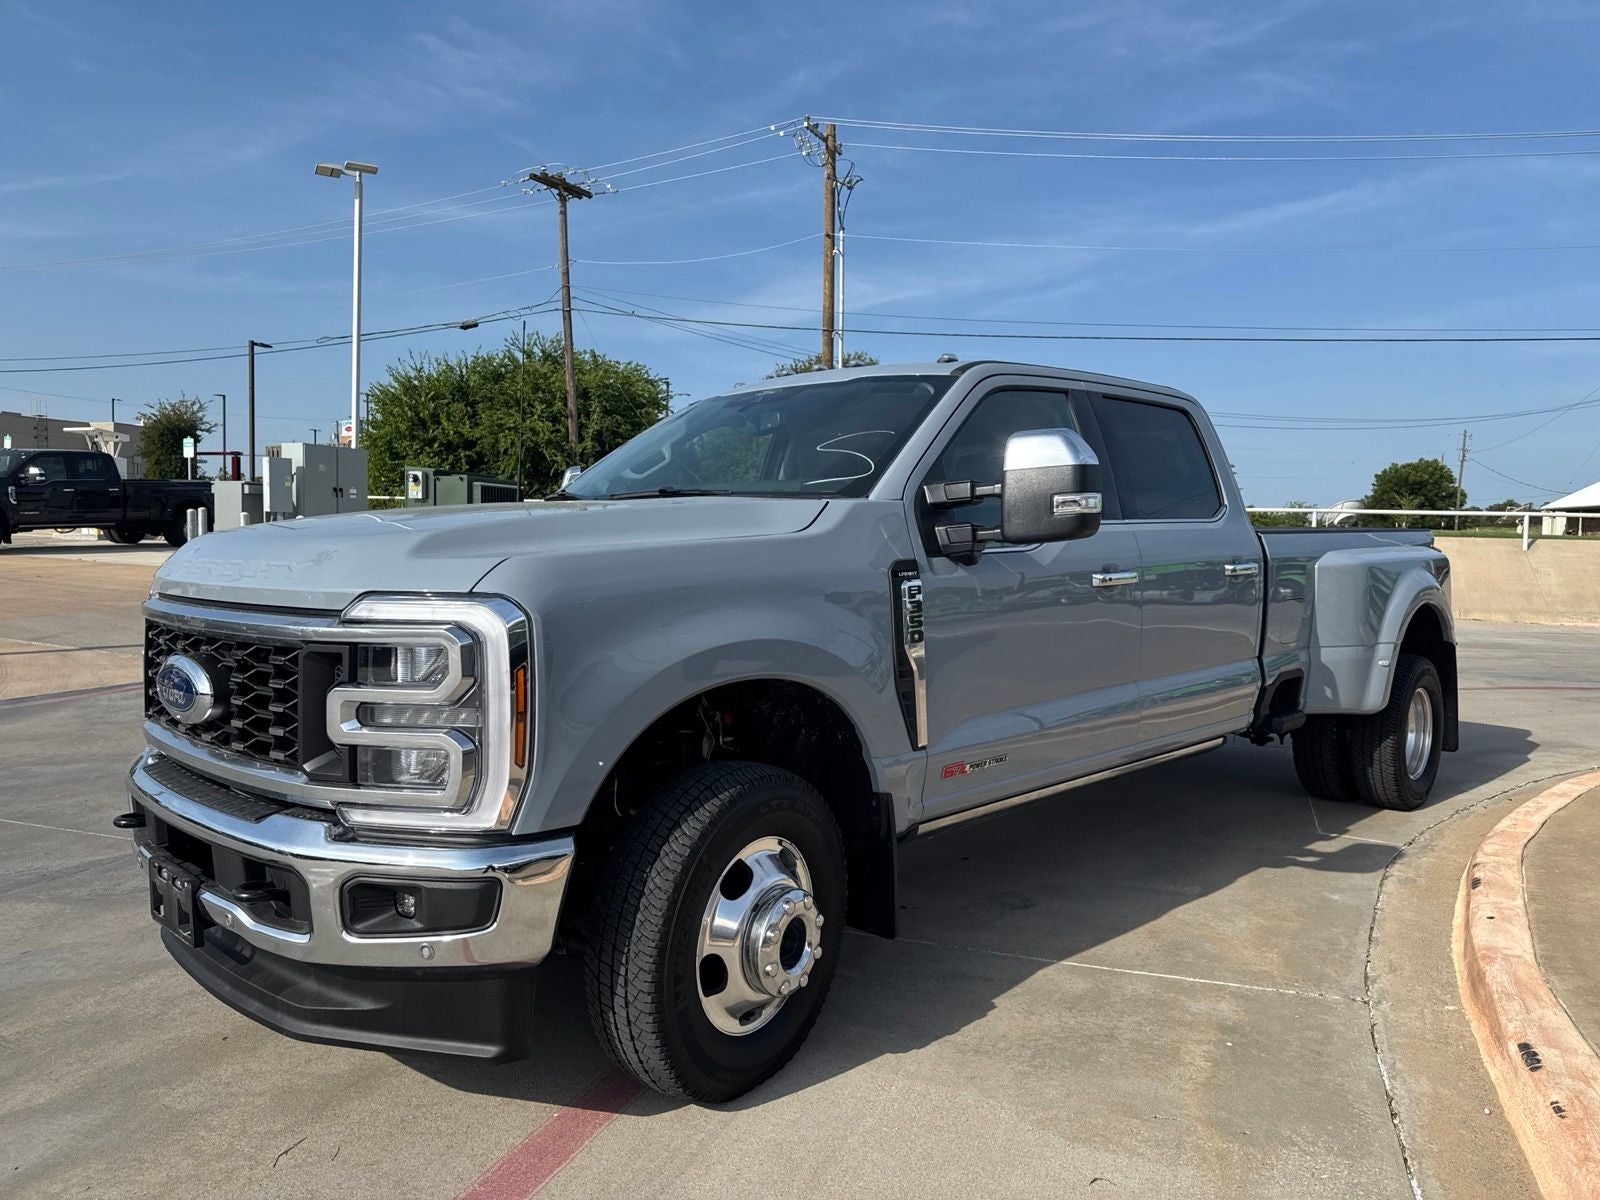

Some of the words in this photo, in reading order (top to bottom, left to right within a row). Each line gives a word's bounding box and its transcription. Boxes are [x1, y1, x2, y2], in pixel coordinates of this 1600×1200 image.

[160, 674, 187, 704] Ford
[969, 761, 987, 770] POWER
[988, 755, 1007, 765] STROKE
